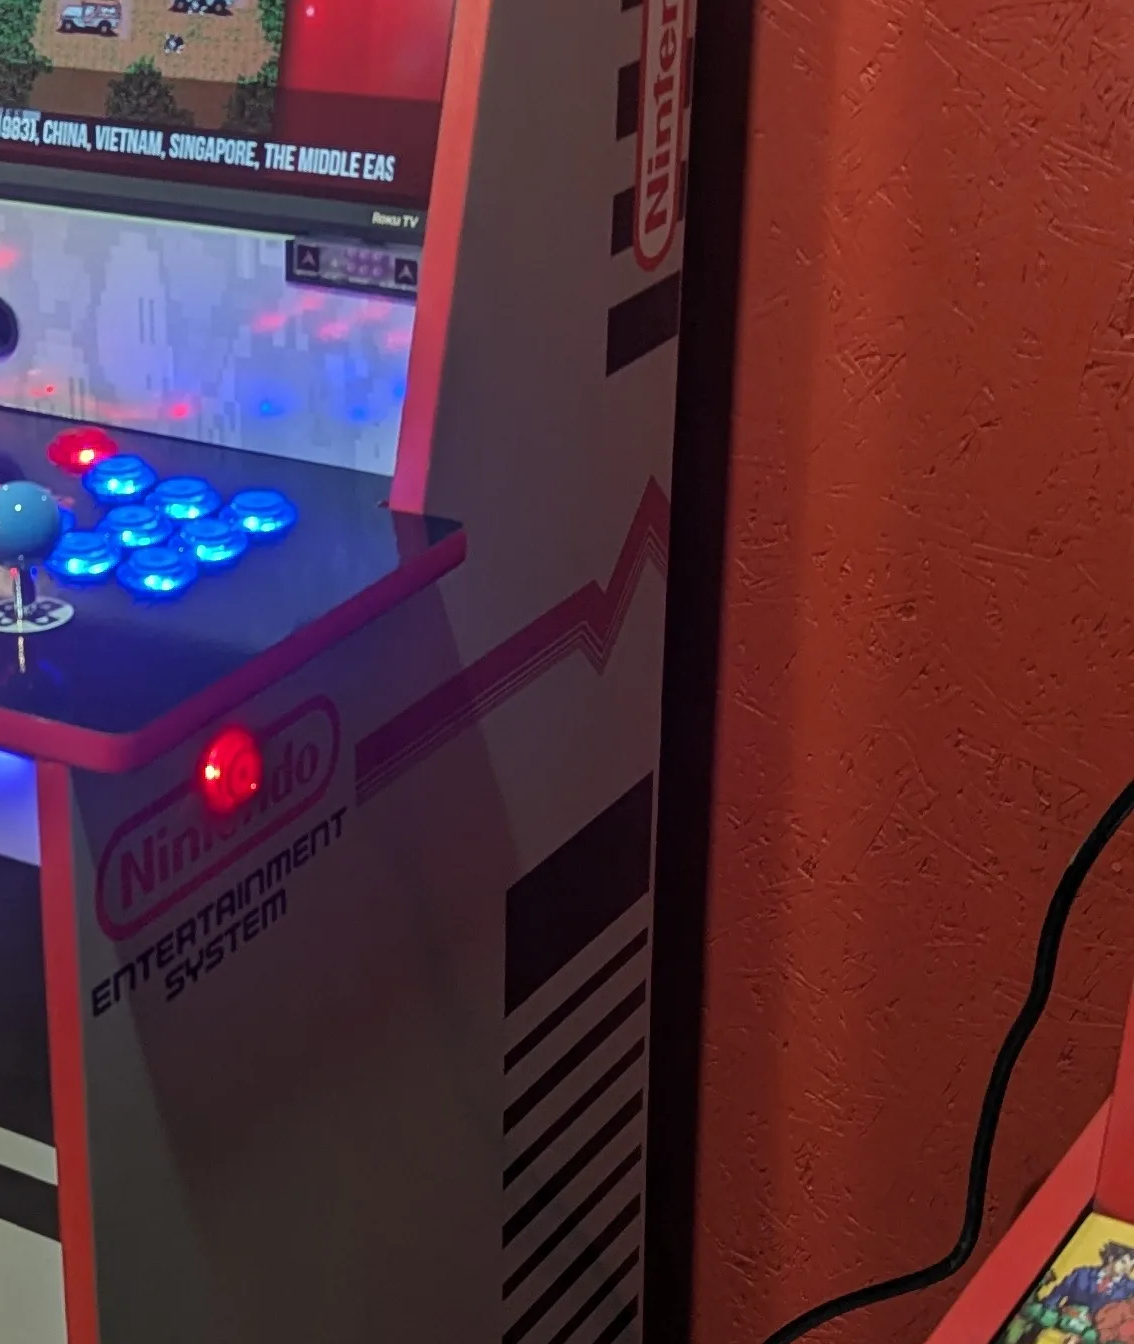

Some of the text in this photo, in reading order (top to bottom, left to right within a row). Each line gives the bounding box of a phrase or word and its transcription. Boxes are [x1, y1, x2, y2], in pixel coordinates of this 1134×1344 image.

[43, 119, 92, 152] CHINA,
[95, 124, 166, 160] VIETNAM,
[169, 133, 260, 171] SINGAPORE,
[264, 142, 297, 171] THE
[297, 146, 362, 179] MIDDLE
[362, 153, 396, 183] EAS
[402, 214, 420, 228] TV
[92, 806, 347, 1018] ENTERTAINMENT
[166, 888, 286, 1002] SYSTEM
